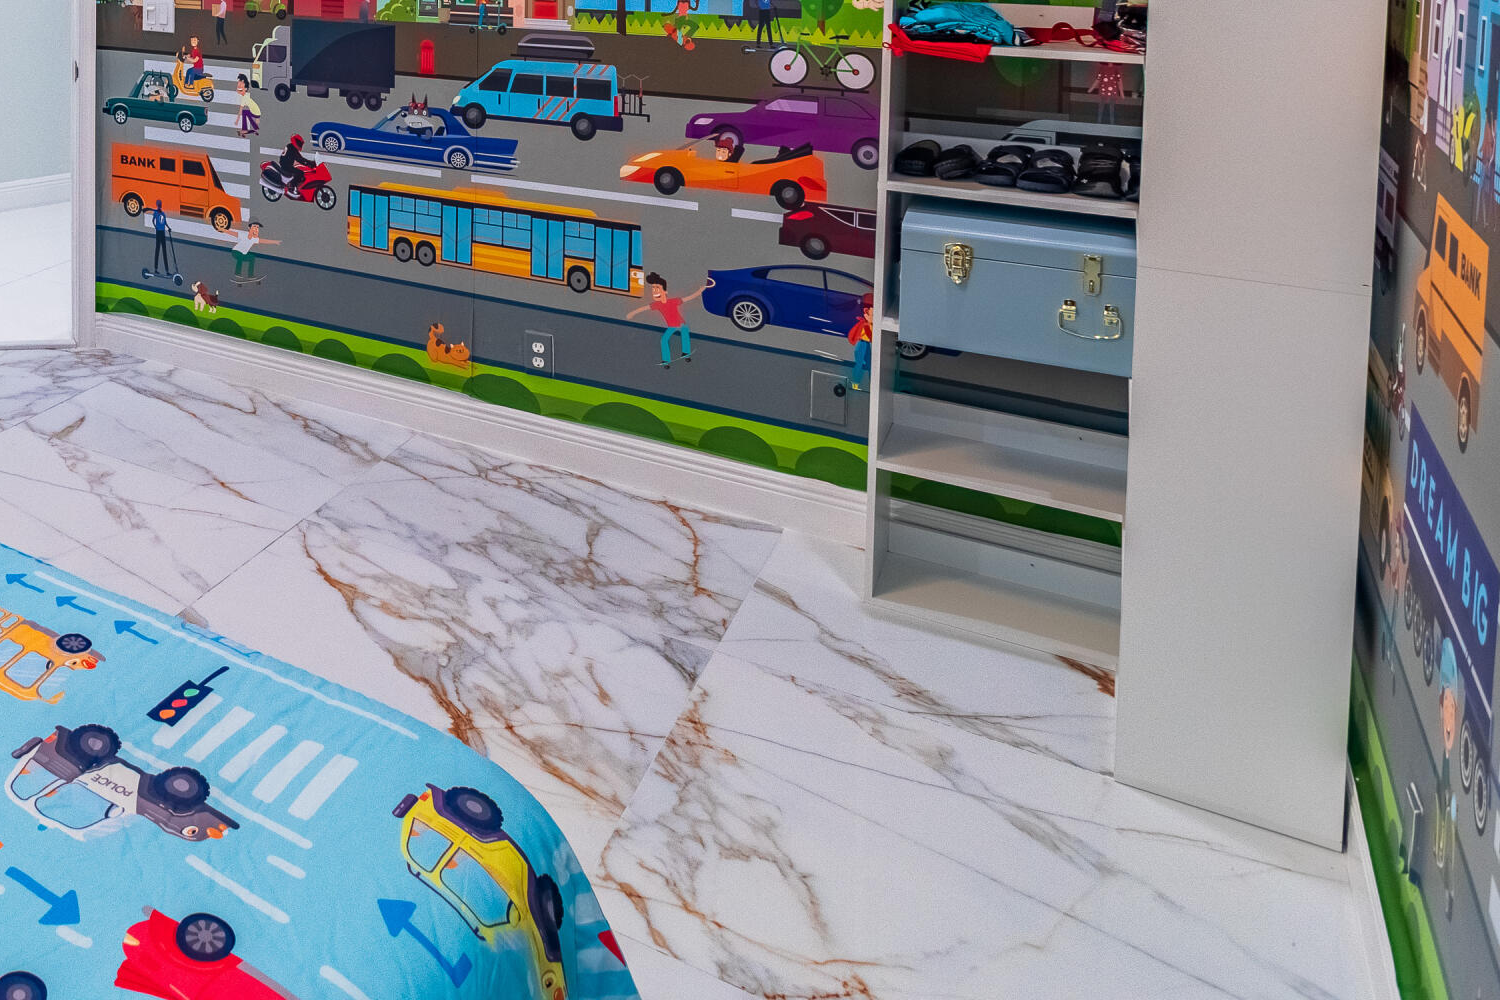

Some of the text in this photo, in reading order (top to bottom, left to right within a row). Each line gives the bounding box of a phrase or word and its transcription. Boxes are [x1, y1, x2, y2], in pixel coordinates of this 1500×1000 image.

[120, 154, 156, 169] BANK
[1460, 252, 1481, 300] BANK
[1410, 440, 1488, 646] DREAM BIG
[90, 773, 134, 797] POLICE
